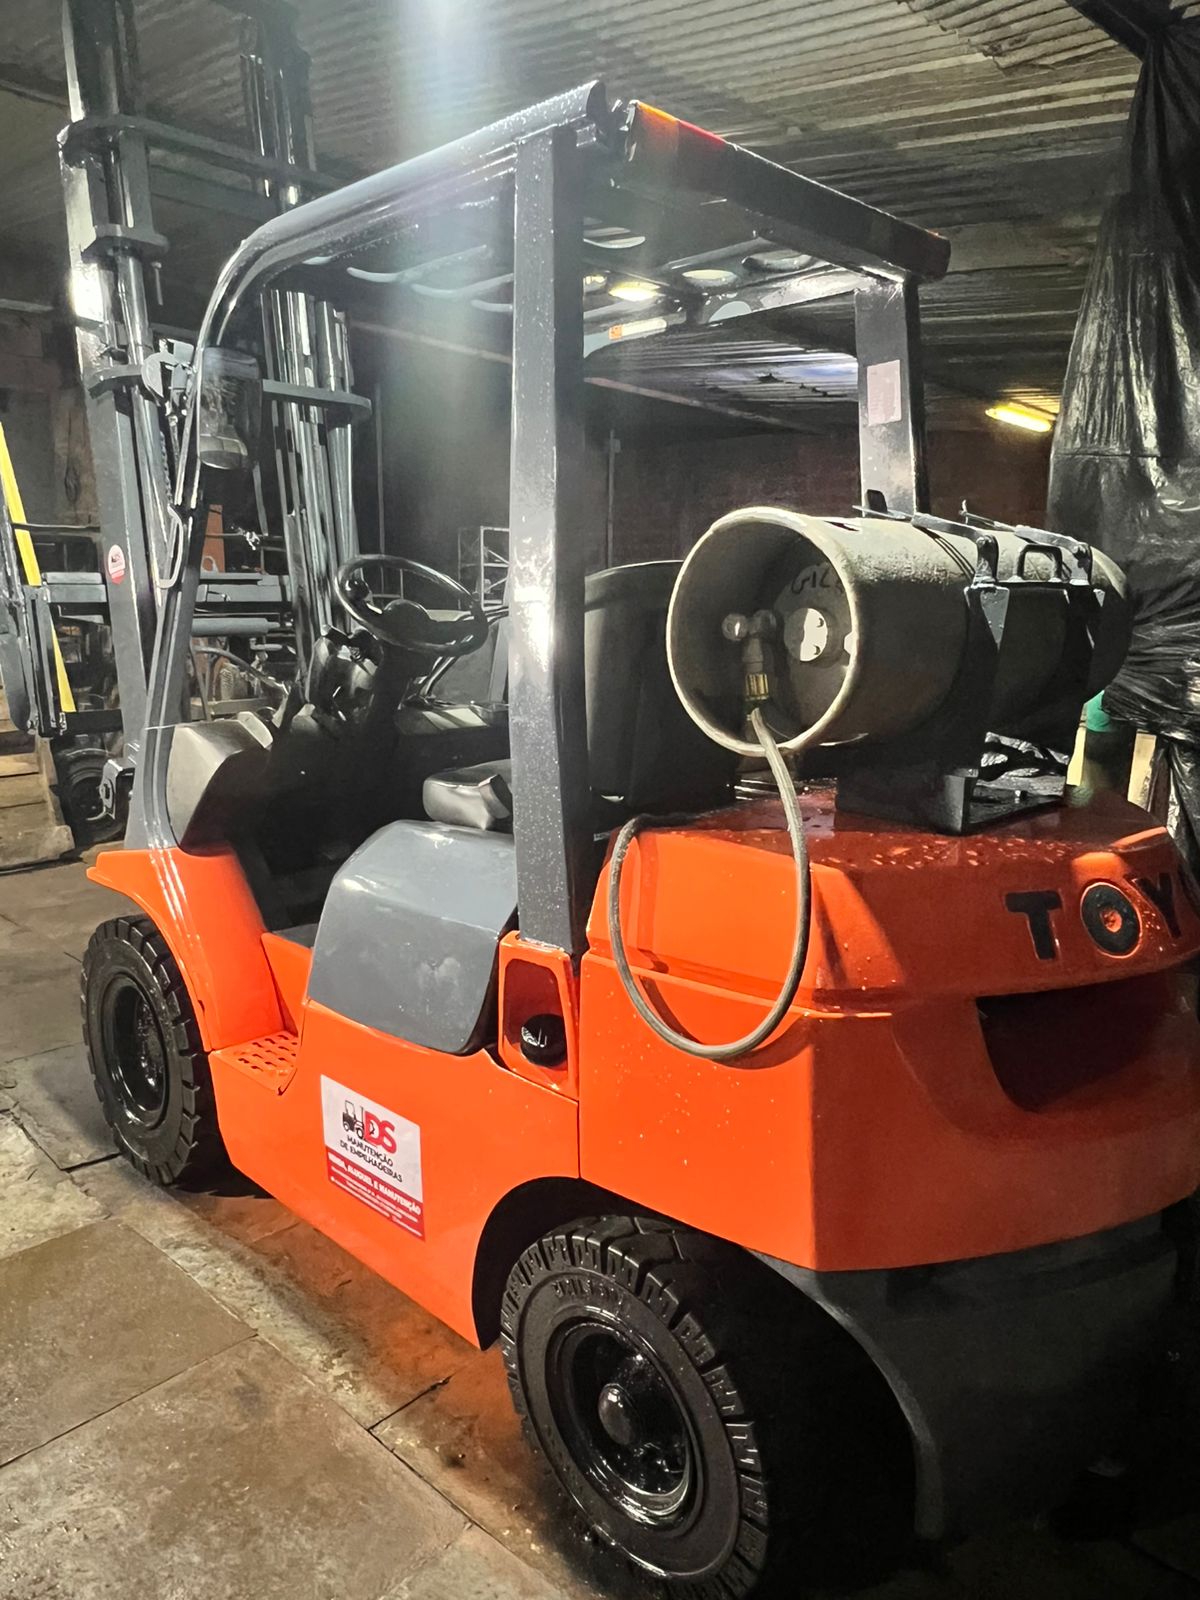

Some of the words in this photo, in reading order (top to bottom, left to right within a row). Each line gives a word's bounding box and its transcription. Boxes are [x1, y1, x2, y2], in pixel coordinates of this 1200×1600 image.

[340, 1140, 349, 1151] DE
[350, 1146, 402, 1182] EMPILHADEIRAS
[347, 1135, 394, 1167] MANUTENÇÃO
